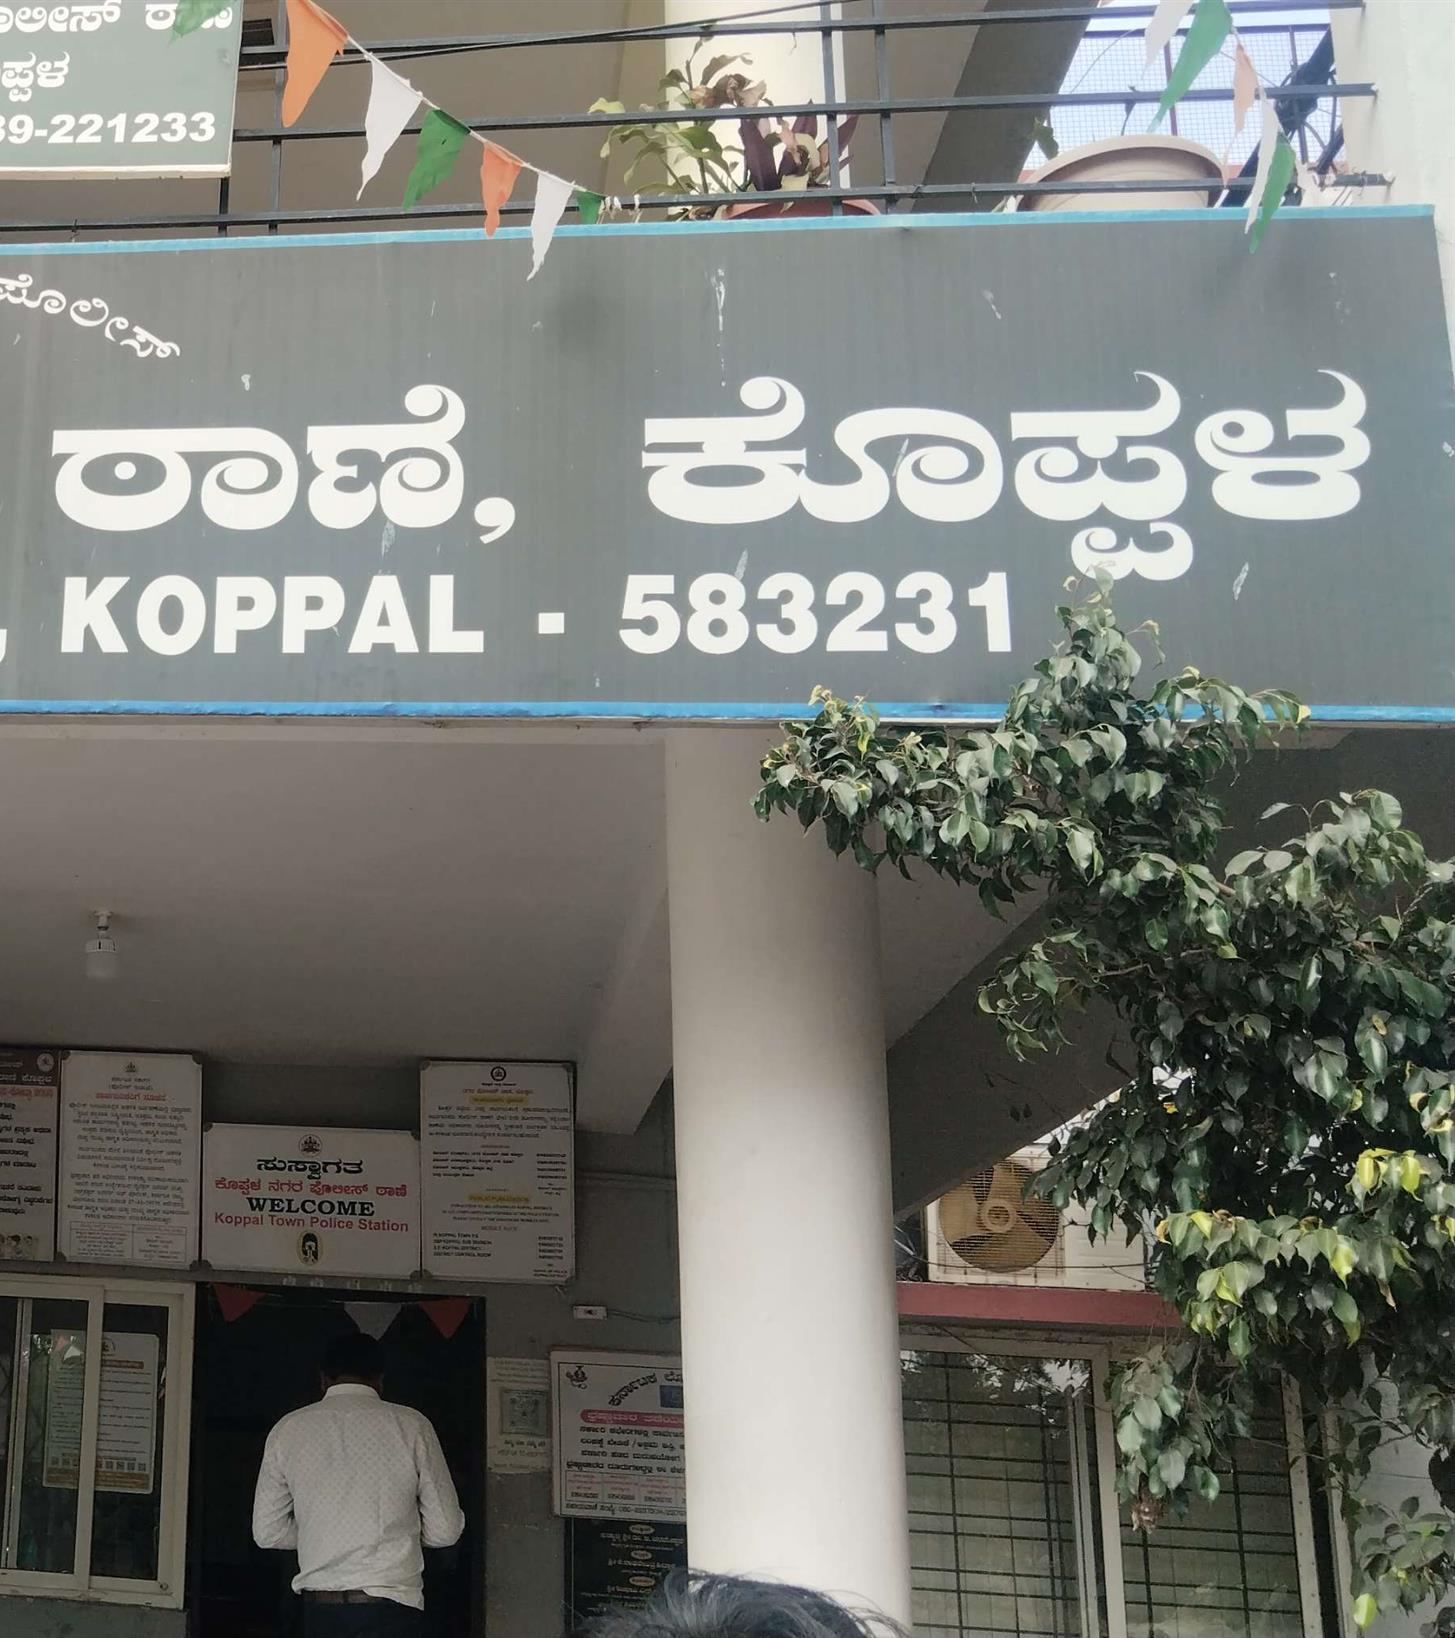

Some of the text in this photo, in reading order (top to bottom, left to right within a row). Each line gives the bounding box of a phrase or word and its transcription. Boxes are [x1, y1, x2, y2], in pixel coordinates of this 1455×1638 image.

[52, 384, 516, 543] ಠಾಣೆ,
[642, 369, 1372, 582] ಕೊಪ್ಪಳ
[60, 573, 485, 655] KOPPAL
[618, 571, 1012, 654] 583231
[256, 1157, 364, 1180] ಸುಸ್ವಾಗತ
[215, 1177, 262, 1195] ಕೊಪ್ಪಳ
[268, 1179, 303, 1193] ನಗರ
[309, 1180, 369, 1196] ಪೊಲೀಸ್
[246, 1197, 375, 1217] WELCOME
[214, 1213, 409, 1232] Koppal Town Police Station
